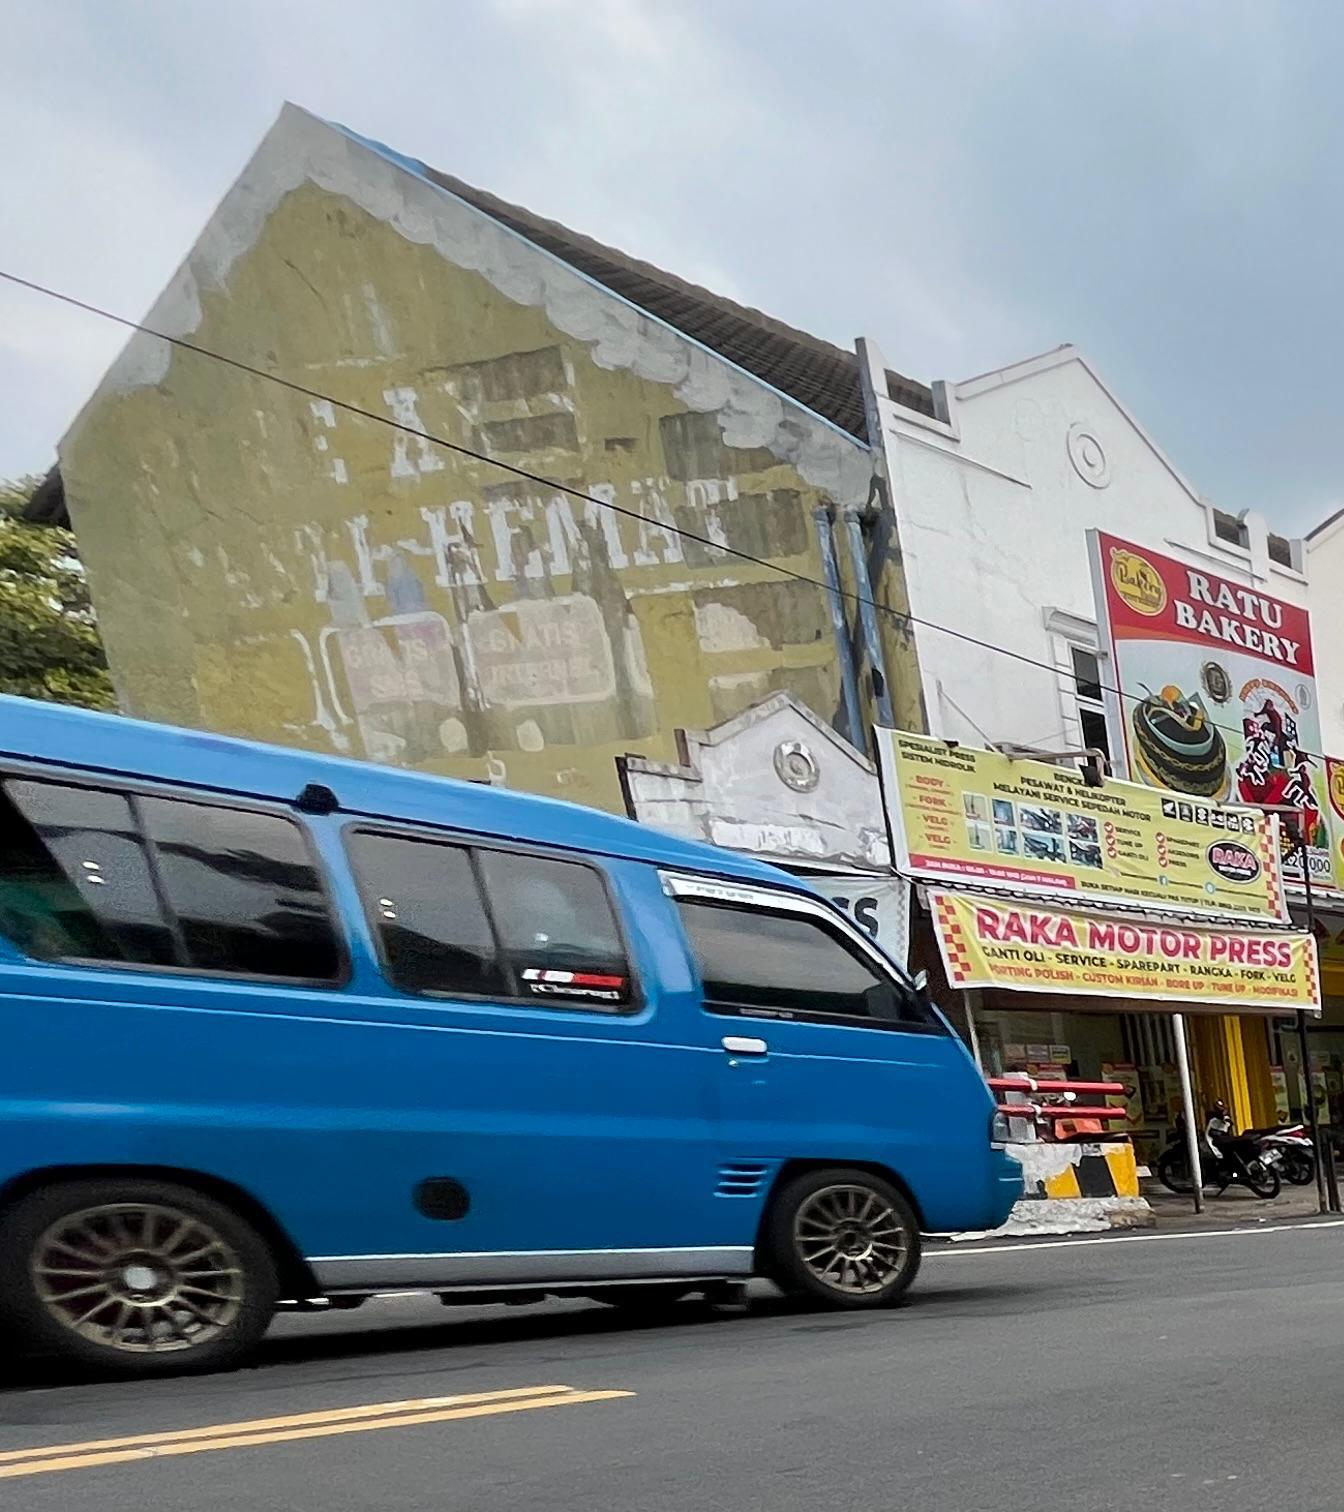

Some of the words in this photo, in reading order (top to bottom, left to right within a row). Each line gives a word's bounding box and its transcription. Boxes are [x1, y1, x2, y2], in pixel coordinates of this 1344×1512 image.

[1185, 570, 1282, 629] RATU
[1174, 600, 1300, 665] BAKERY
[993, 782, 1041, 800] MELAYANI
[1043, 791, 1079, 808] SERVICE
[1123, 807, 1151, 822] MOTOR
[1021, 776, 1066, 793] PESAWAT
[1074, 788, 1126, 806] HELIKOPTER
[923, 814, 948, 826] VELG
[924, 833, 951, 845] VELG
[1211, 846, 1257, 871] RAKA
[976, 907, 1080, 949] RAKA
[1088, 920, 1202, 960] MOTOR
[1209, 934, 1292, 968] PRESS
[982, 946, 1020, 961] GANTI
[1023, 950, 1045, 963] OLI
[1055, 953, 1106, 969] SERVICE
[1117, 959, 1180, 974] SPAREPART
[1190, 965, 1233, 978] RANGKA
[1240, 969, 1266, 981] FORK
[1272, 971, 1297, 984] VELG
[1035, 968, 1074, 980] POLISH
[1082, 972, 1124, 985] CUSTOM
[1192, 981, 1205, 991] UP
[1210, 982, 1234, 993] TUNE
[1235, 984, 1247, 994] UP
